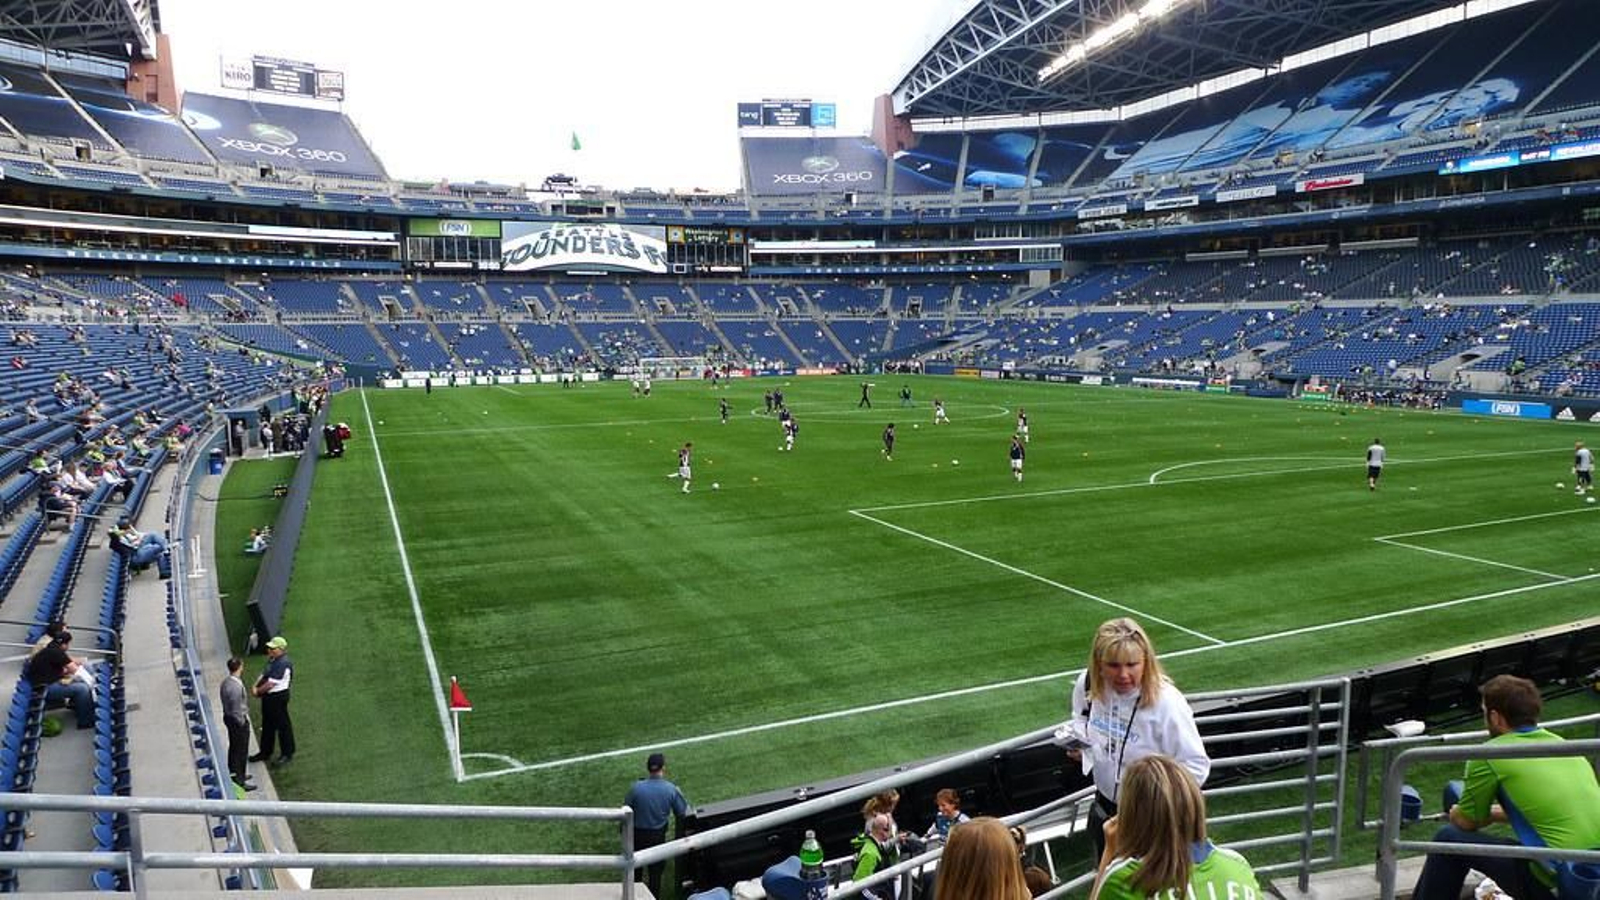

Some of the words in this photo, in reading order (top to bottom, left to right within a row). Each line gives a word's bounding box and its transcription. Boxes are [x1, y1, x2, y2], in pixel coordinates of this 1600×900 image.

[217, 137, 296, 158] XBOX
[297, 147, 347, 163] 360
[774, 174, 831, 184] XBOX
[833, 170, 873, 182] 360
[66, 249, 161, 261] WELCOME
[178, 254, 199, 263] TO
